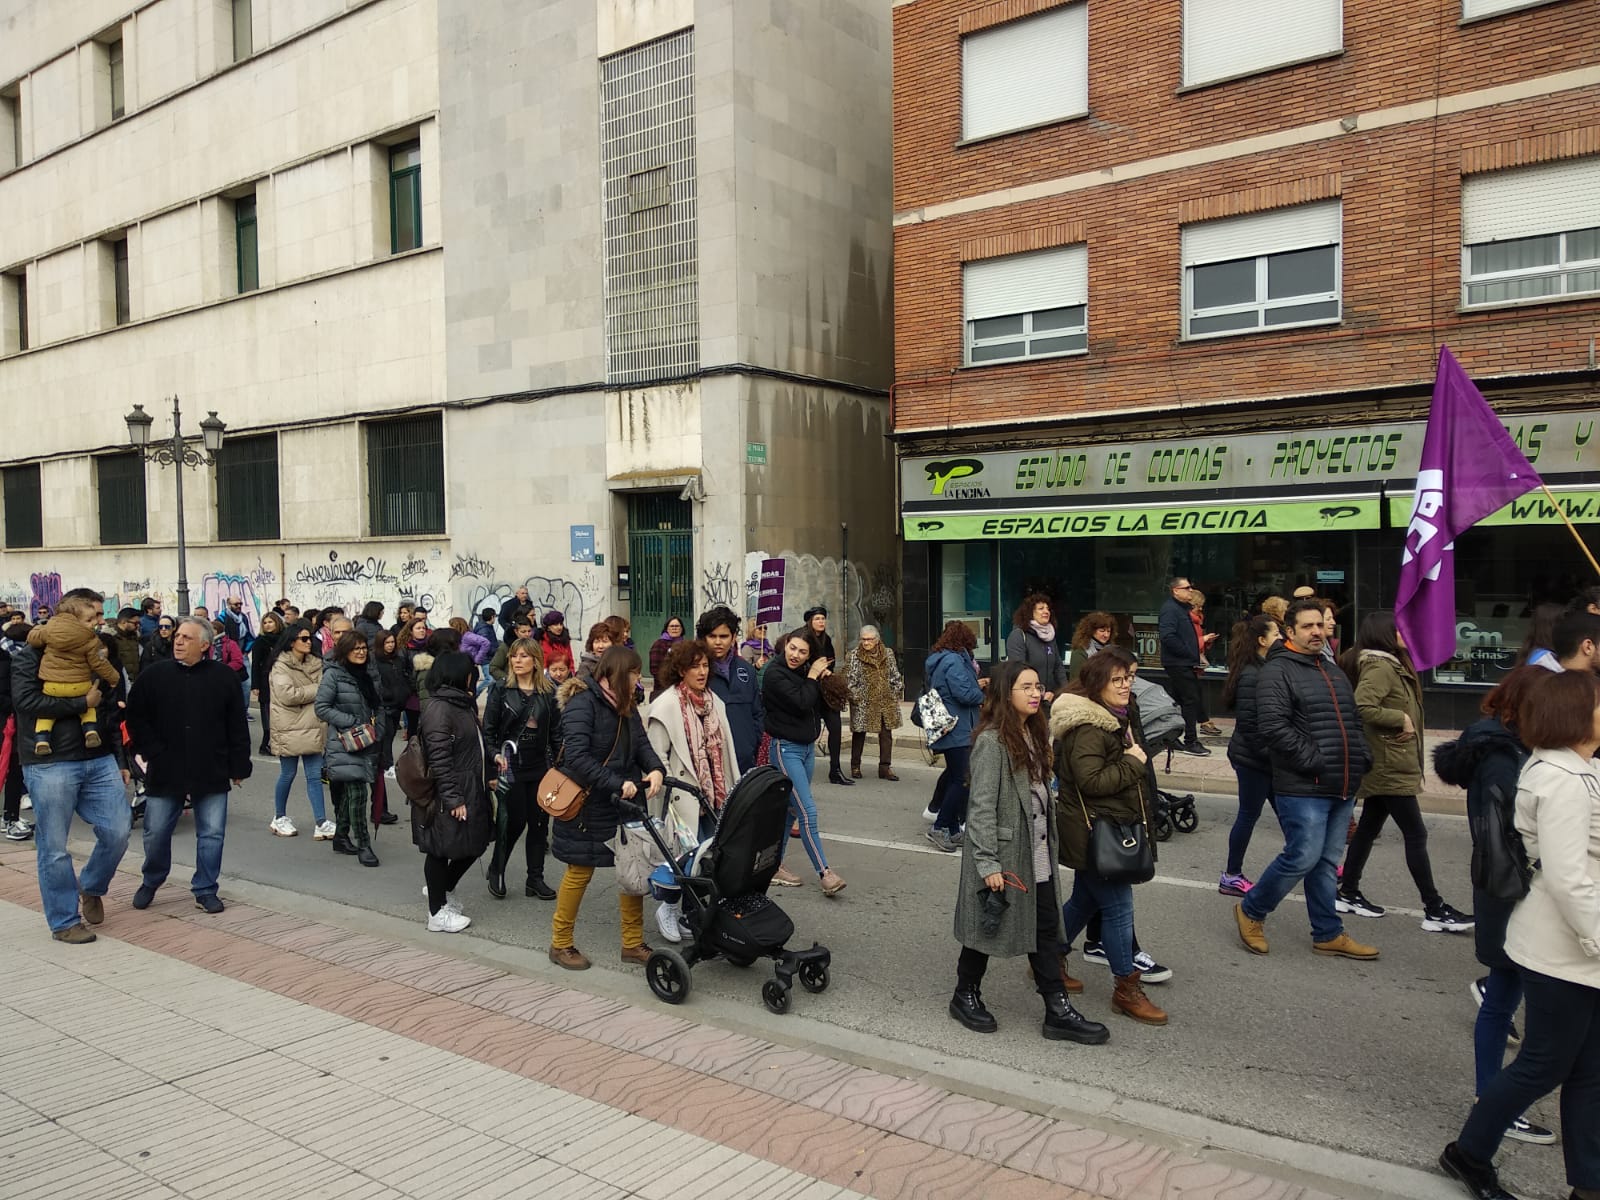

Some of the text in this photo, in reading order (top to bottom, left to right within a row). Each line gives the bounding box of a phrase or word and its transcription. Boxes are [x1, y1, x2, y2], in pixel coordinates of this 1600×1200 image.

[1015, 453, 1088, 490] ESTUDIO
[1103, 451, 1132, 486] DE
[1147, 446, 1228, 483] COCINAS
[1270, 433, 1403, 478] PROYECTOS
[1575, 420, 1594, 462] Y
[944, 487, 991, 498] LA ENCINA
[982, 509, 1268, 535] ESPACIOS LA ENCINA
[1137, 638, 1157, 655] 10
[1455, 621, 1503, 648] Gm
